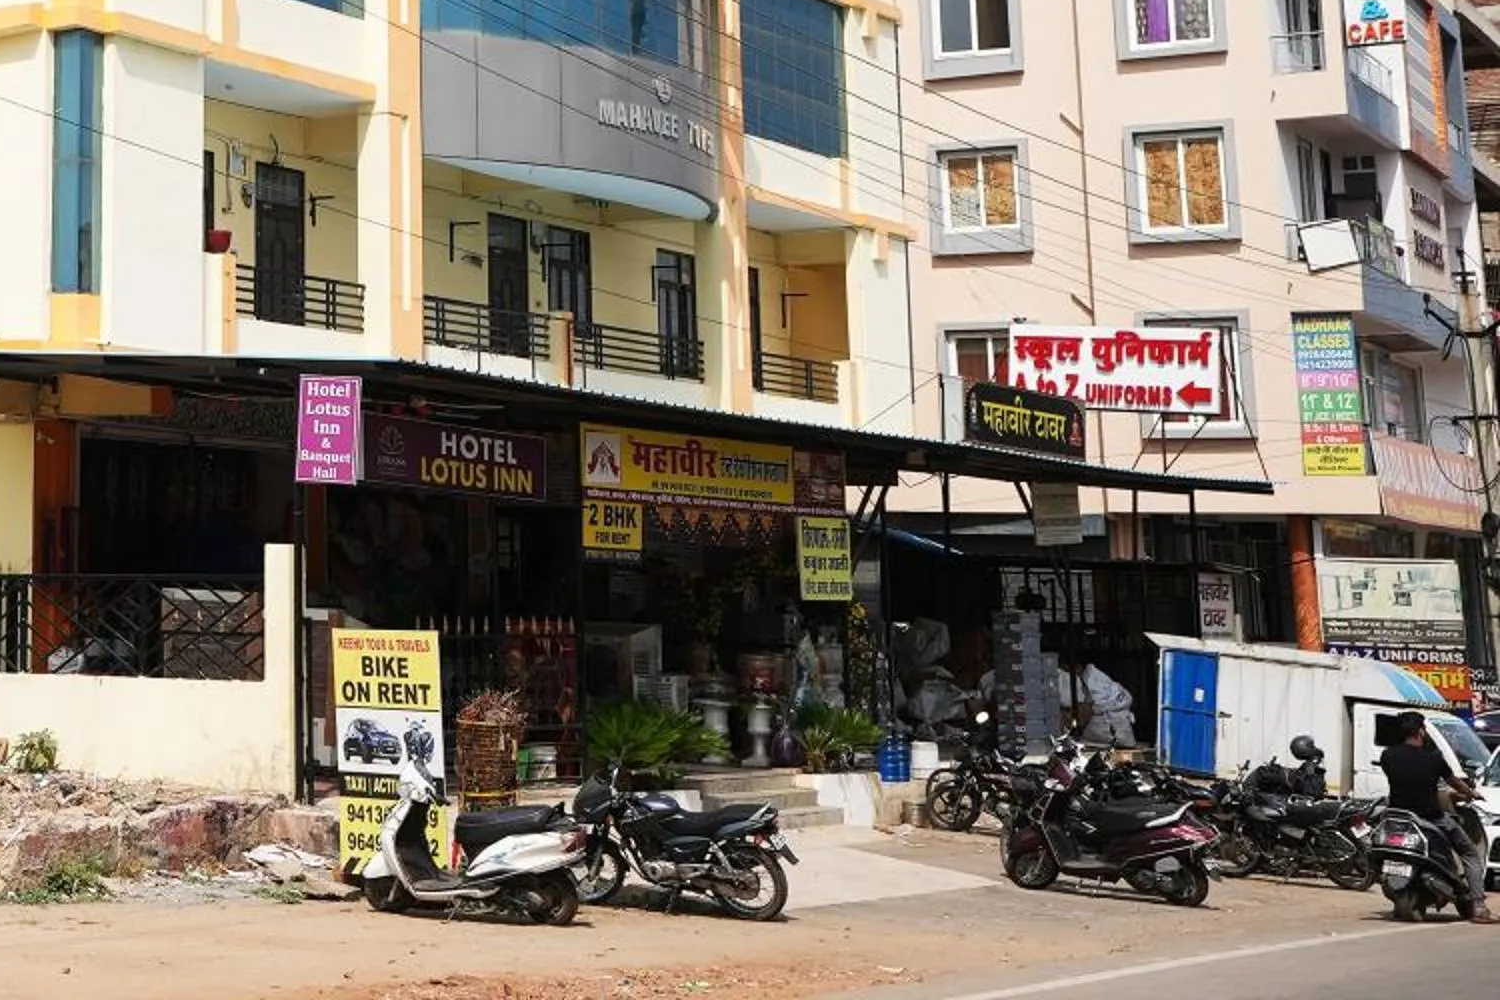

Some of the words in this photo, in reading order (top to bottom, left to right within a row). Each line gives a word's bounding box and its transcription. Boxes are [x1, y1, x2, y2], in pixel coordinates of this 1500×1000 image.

[1347, 19, 1405, 44] CAFE
[1298, 333, 1350, 349] CLASSES
[1013, 335, 1084, 371] स्कूल
[307, 381, 351, 398] Hotel
[1014, 372, 1027, 393] A
[1064, 373, 1080, 399] Z
[1085, 382, 1173, 408] UNIFORMS
[306, 400, 351, 417] Lotus
[981, 395, 1032, 437] महावीर
[1033, 410, 1068, 444] टावर
[313, 419, 341, 435] Inn
[321, 437, 331, 449] &
[440, 430, 518, 465] HOTEL
[301, 449, 351, 464] Banquet
[312, 466, 337, 479] Hall
[420, 455, 487, 490] LOTUS
[493, 465, 534, 495] INN
[589, 503, 599, 526] 2
[603, 503, 637, 529] BHK
[361, 655, 409, 678] BIKE
[1378, 650, 1465, 665] UNIFORMS
[342, 680, 371, 703] ON
[378, 682, 431, 706] RENT
